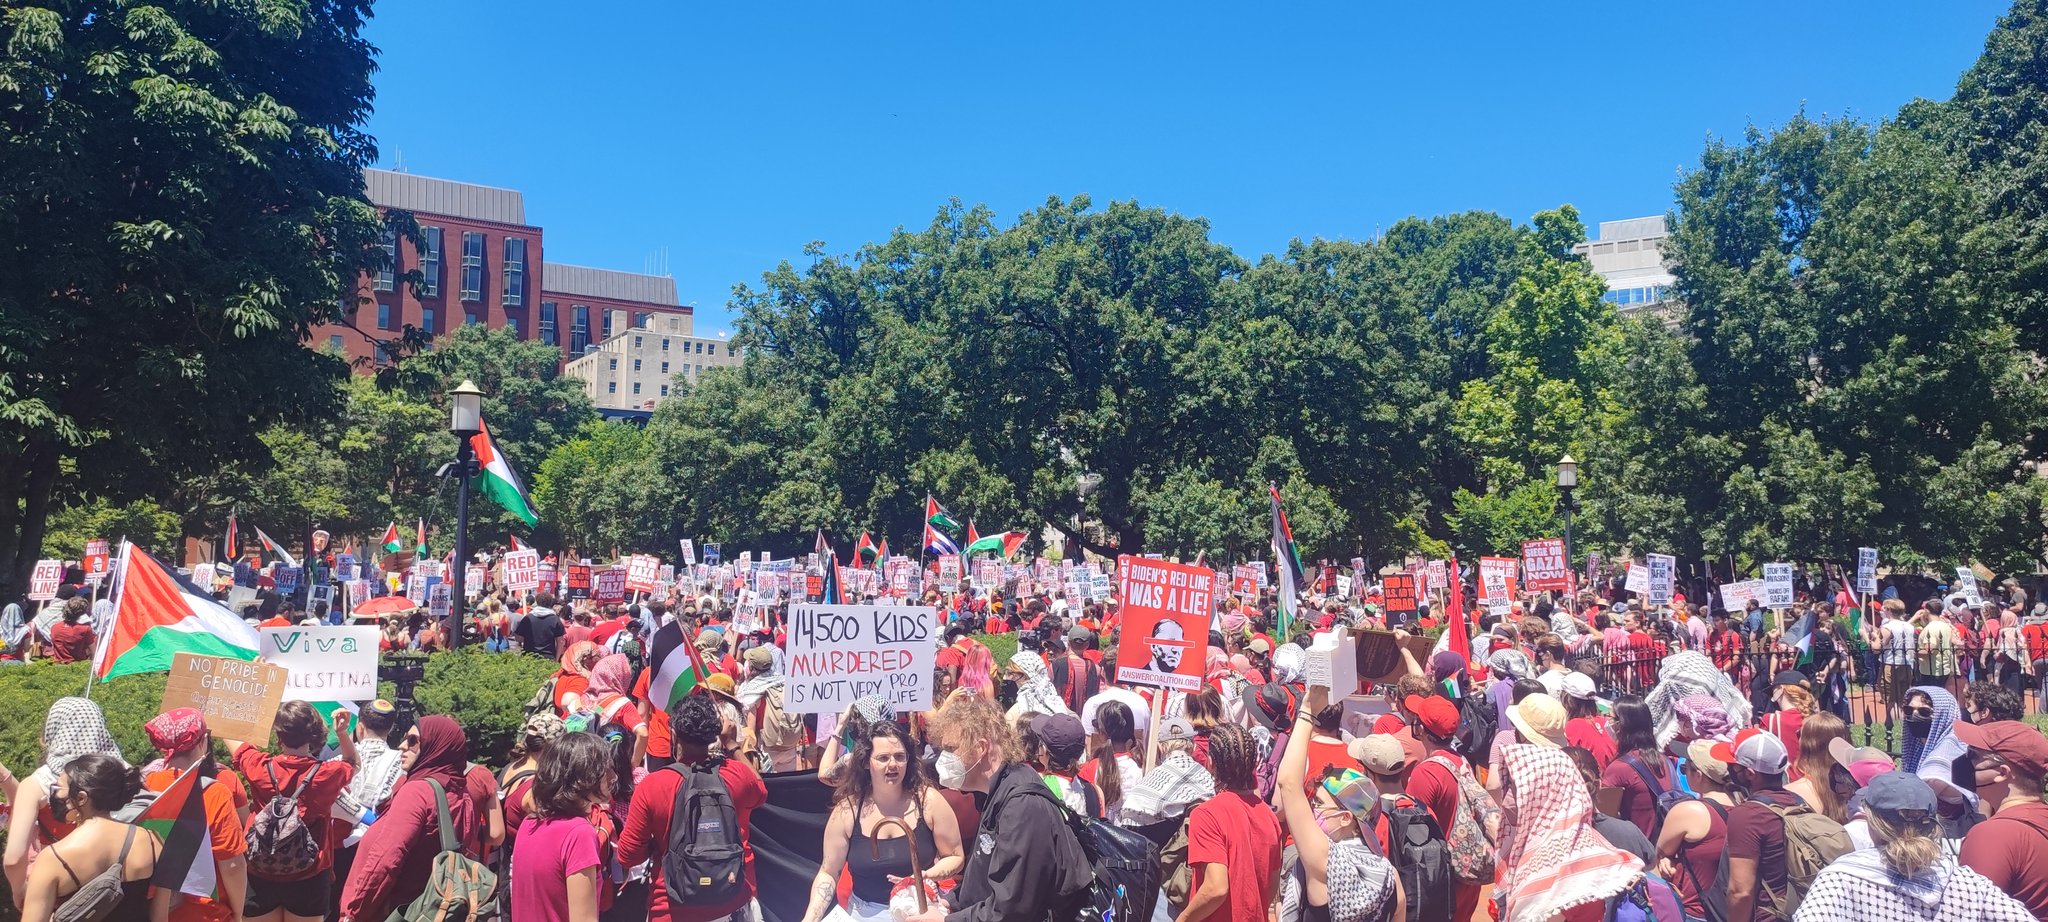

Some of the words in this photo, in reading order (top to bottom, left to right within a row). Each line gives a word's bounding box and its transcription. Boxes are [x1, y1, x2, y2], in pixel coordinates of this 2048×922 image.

[1525, 548, 1548, 557] SIEGE
[1550, 547, 1562, 556] ON
[508, 555, 536, 570] RED
[1430, 565, 1444, 574] RED
[1526, 556, 1564, 571] GAZA
[36, 566, 60, 578] RED
[508, 570, 537, 584] LINE
[942, 572, 958, 580] ARMS
[1131, 564, 1167, 584] BIDEN'S
[1170, 571, 1186, 588] RED
[1189, 574, 1210, 591] LINE
[1432, 575, 1446, 583] LINE
[1528, 571, 1565, 580] NOW
[33, 582, 57, 594] LINE
[600, 582, 624, 592] GAZA
[1386, 589, 1397, 598] U.S.
[1129, 582, 1163, 609] WAS
[1166, 588, 1176, 612] A
[1181, 590, 1208, 616] LIE!
[1387, 598, 1416, 611] ISRAEL
[1490, 598, 1509, 607] ISRAEL
[795, 608, 860, 648] 14,500
[874, 610, 928, 644] KIDS
[272, 632, 358, 653] Viva
[190, 658, 212, 672] NO
[222, 661, 260, 680] PRIDE
[267, 669, 278, 682] IN
[791, 650, 912, 678] MURDERED
[201, 674, 268, 698] GENOCIDE
[1121, 670, 1198, 688] ANSWERCOALITION.ORG
[791, 684, 805, 703] IS
[812, 680, 846, 701] NOT
[850, 680, 882, 699] VERY
